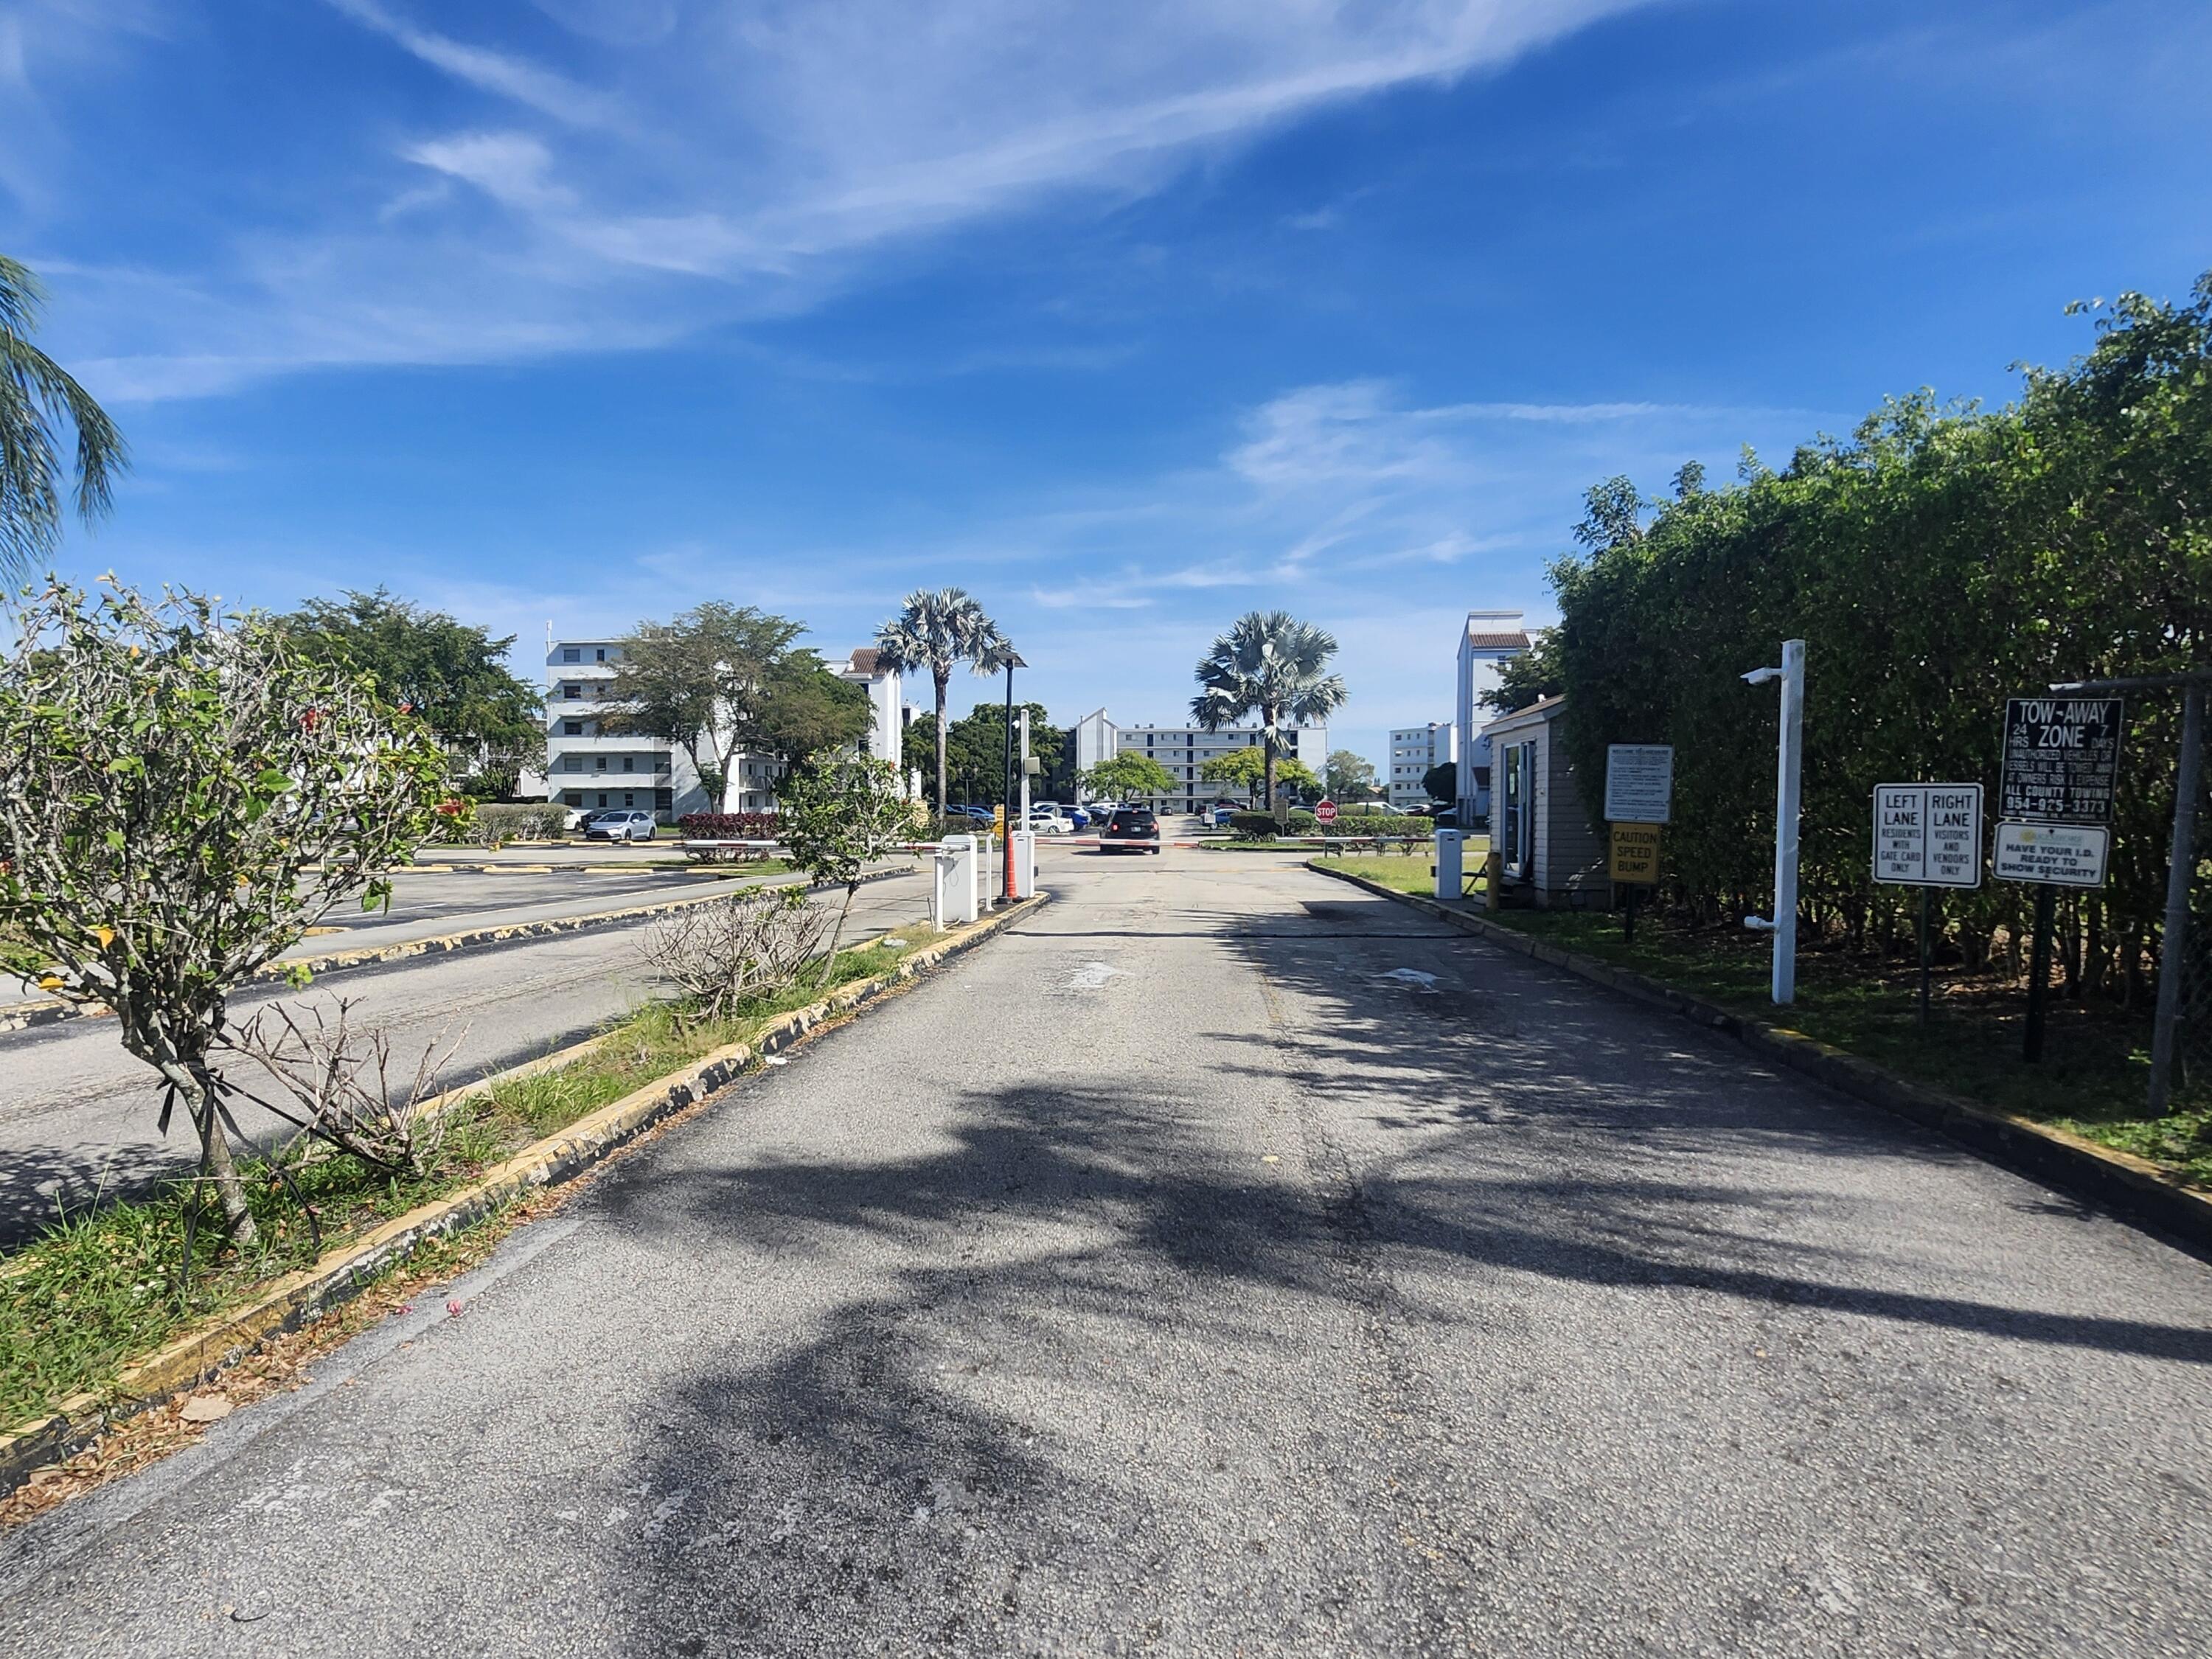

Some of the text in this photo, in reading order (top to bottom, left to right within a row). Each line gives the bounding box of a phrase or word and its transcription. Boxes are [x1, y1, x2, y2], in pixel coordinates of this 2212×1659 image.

[2020, 701, 2110, 723] TOW-AWAY
[2013, 723, 2027, 735] 24
[2100, 725, 2109, 736] 7
[2008, 737, 2028, 748] HRS
[2038, 726, 2085, 748] ZONE
[2091, 738, 2115, 749] DAYS
[2008, 748, 2061, 760] UNAUTHORIZED
[2064, 750, 2098, 761] VEHICLES
[2038, 762, 2053, 772] WILL
[2056, 762, 2065, 773] BE
[2049, 773, 2065, 785] RISK
[2076, 775, 2110, 786] EXPENSE
[2005, 785, 2110, 799] ALL COUNTY TOWING
[1886, 795, 1917, 808] LEFT
[1932, 795, 1972, 809] RIGHT
[2006, 796, 2105, 812] 954-925-3373
[1317, 807, 1335, 816] STOP
[1885, 812, 1919, 825] LANE
[1933, 813, 1969, 827] LANE
[1613, 831, 1657, 844] CAUTION
[1882, 829, 1921, 838] RESIDENTS
[1934, 830, 1969, 841] VISITORS
[1893, 840, 1910, 849] WITH
[1944, 842, 1959, 852] AND
[1617, 846, 1651, 858] SPEED
[1881, 851, 1921, 861] GATE CARD
[2006, 844, 2094, 858] HAVE YOUR I.D.
[1933, 853, 1969, 864] VENDORS
[2020, 855, 2077, 866] READY TO
[1618, 860, 1649, 873] BUMP
[1891, 863, 1910, 872] ONLY
[1941, 865, 1961, 875] ONLY
[2001, 863, 2096, 877] SHOW SECURITY
